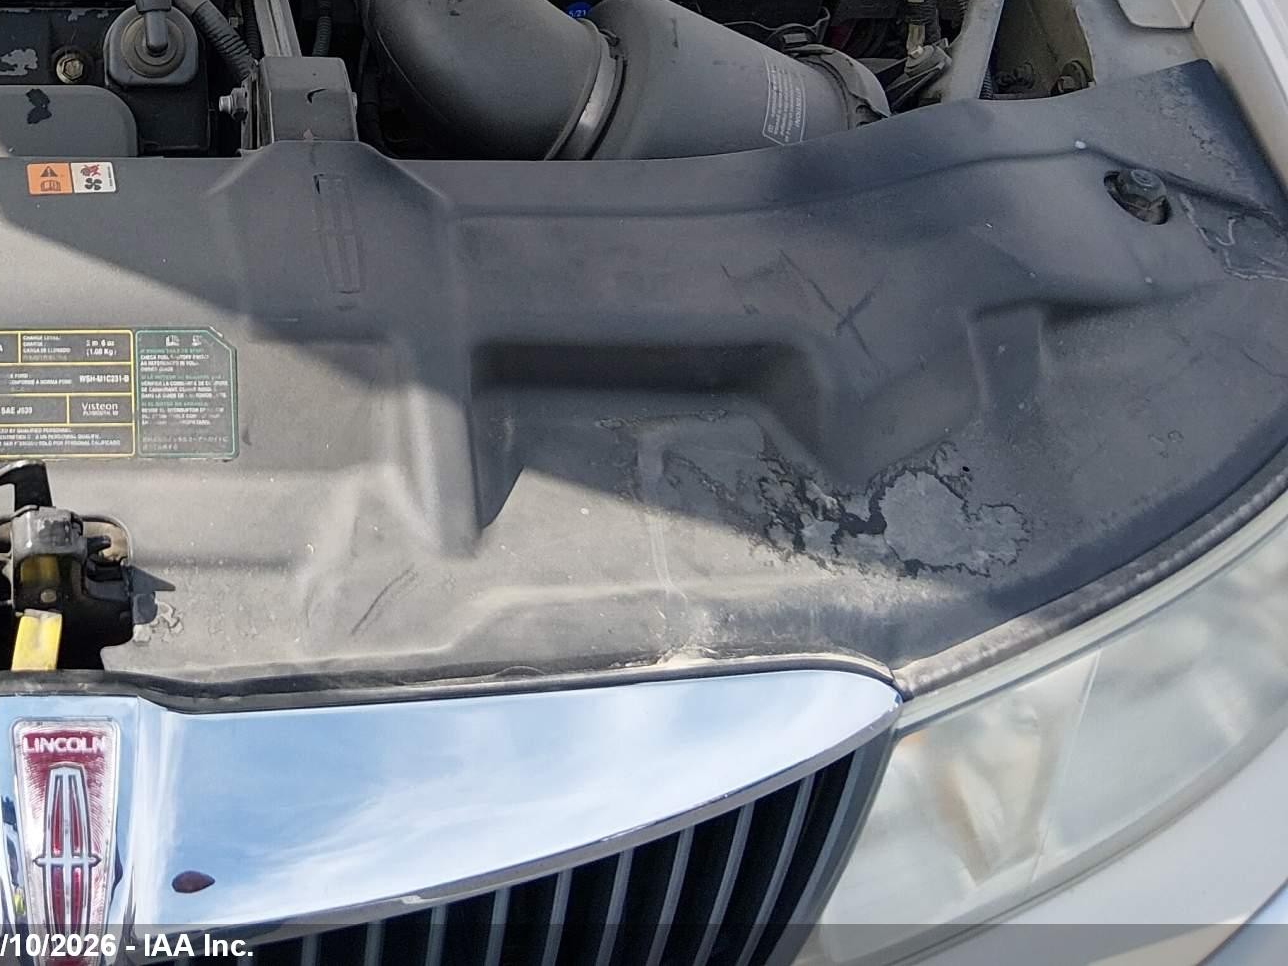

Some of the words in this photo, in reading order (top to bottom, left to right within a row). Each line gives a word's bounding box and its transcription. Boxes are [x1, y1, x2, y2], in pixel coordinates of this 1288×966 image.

[1, 406, 15, 415] SAE
[81, 401, 119, 411] Visteon
[22, 736, 106, 754] LINCOLN
